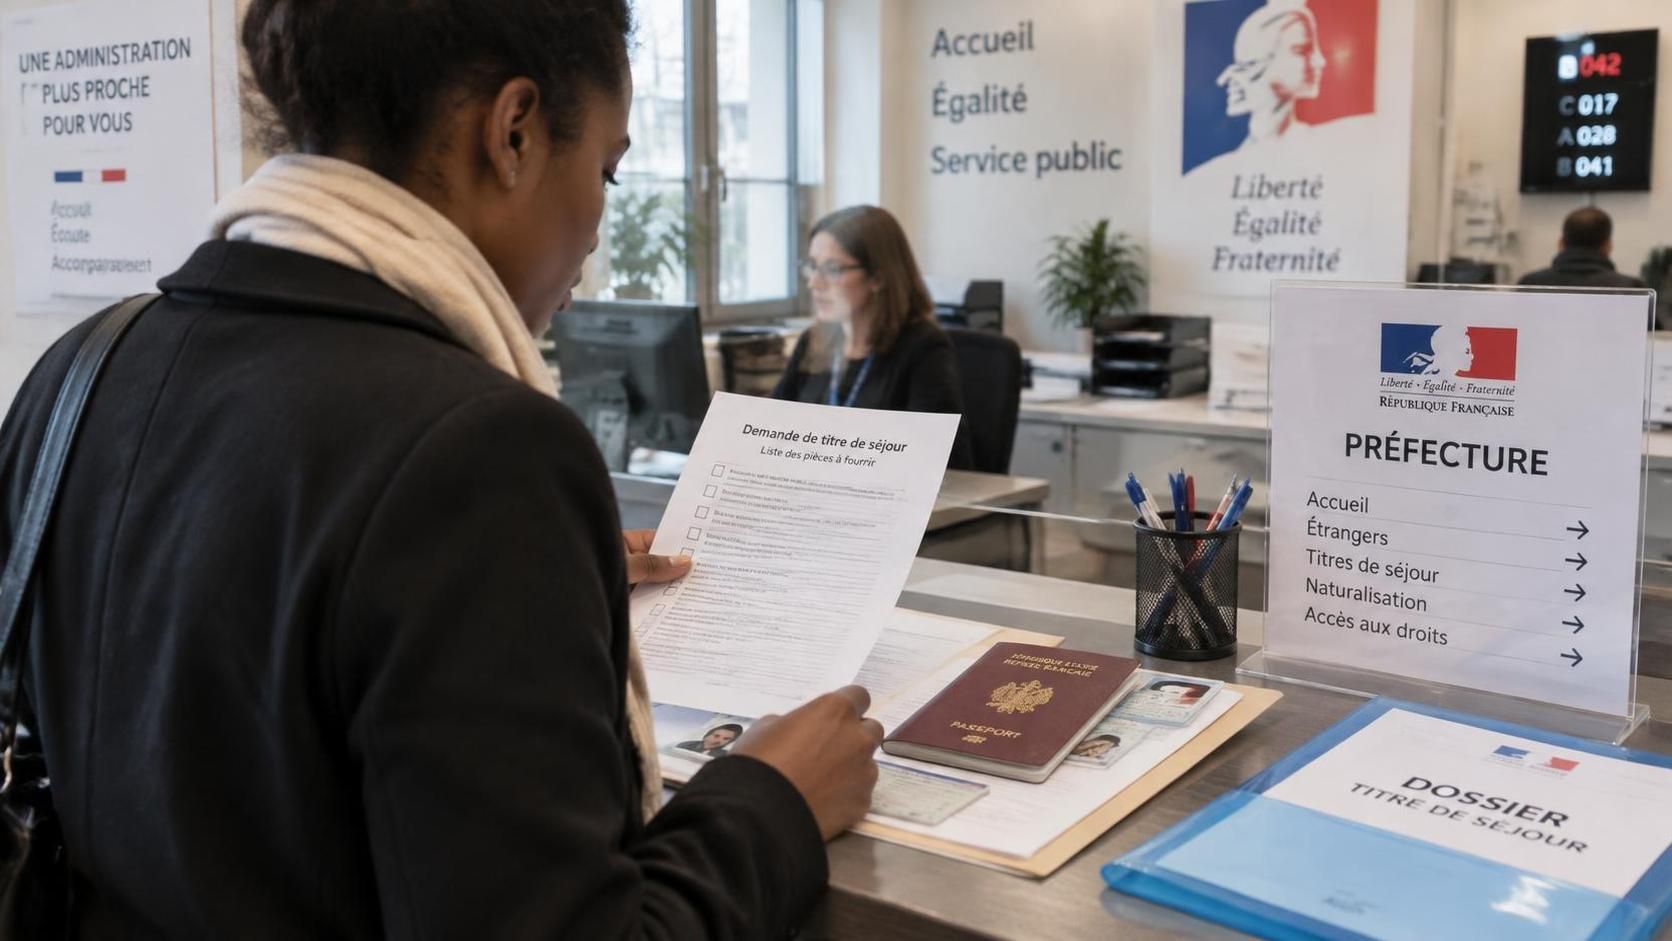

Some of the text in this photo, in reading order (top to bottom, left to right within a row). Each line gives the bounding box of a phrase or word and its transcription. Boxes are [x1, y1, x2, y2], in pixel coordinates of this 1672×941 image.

[931, 20, 1035, 57] Accueil
[19, 37, 192, 73] UNE ADMINISTRATION
[1580, 52, 1622, 78] 042
[42, 81, 80, 104] PLUS
[85, 76, 150, 101] PROCHE
[932, 81, 1028, 124] Égalité
[1559, 92, 1619, 116] C 017
[43, 112, 133, 135] POUR VOUS
[1557, 124, 1617, 147] A 028
[931, 140, 1122, 179] Service public
[1575, 156, 1613, 177] 041
[1231, 173, 1324, 199] Liberté
[1232, 205, 1322, 242] Égalité
[1212, 246, 1342, 271] Fraternité
[1380, 377, 1413, 389] Liberté
[1466, 383, 1516, 396] Fraternité
[1380, 395, 1515, 418] RÉPUBLIQUE FRANÇAISE
[742, 424, 908, 454] Demande de titre de séjour
[1345, 431, 1549, 476] PRÉFECTURE
[760, 446, 783, 457] Liste
[785, 449, 802, 460] des
[803, 451, 833, 464] pièces
[835, 454, 842, 464] à
[1306, 491, 1369, 513] Accueil
[1307, 516, 1389, 546] Étrangers
[1306, 548, 1440, 583] Titres de séjour
[1306, 577, 1427, 612] Naturalisation
[1304, 606, 1448, 645] Accès aux droits
[1350, 782, 1426, 809] TITRE
[1429, 804, 1469, 822] DE
[1401, 776, 1569, 828] DOSSIER
